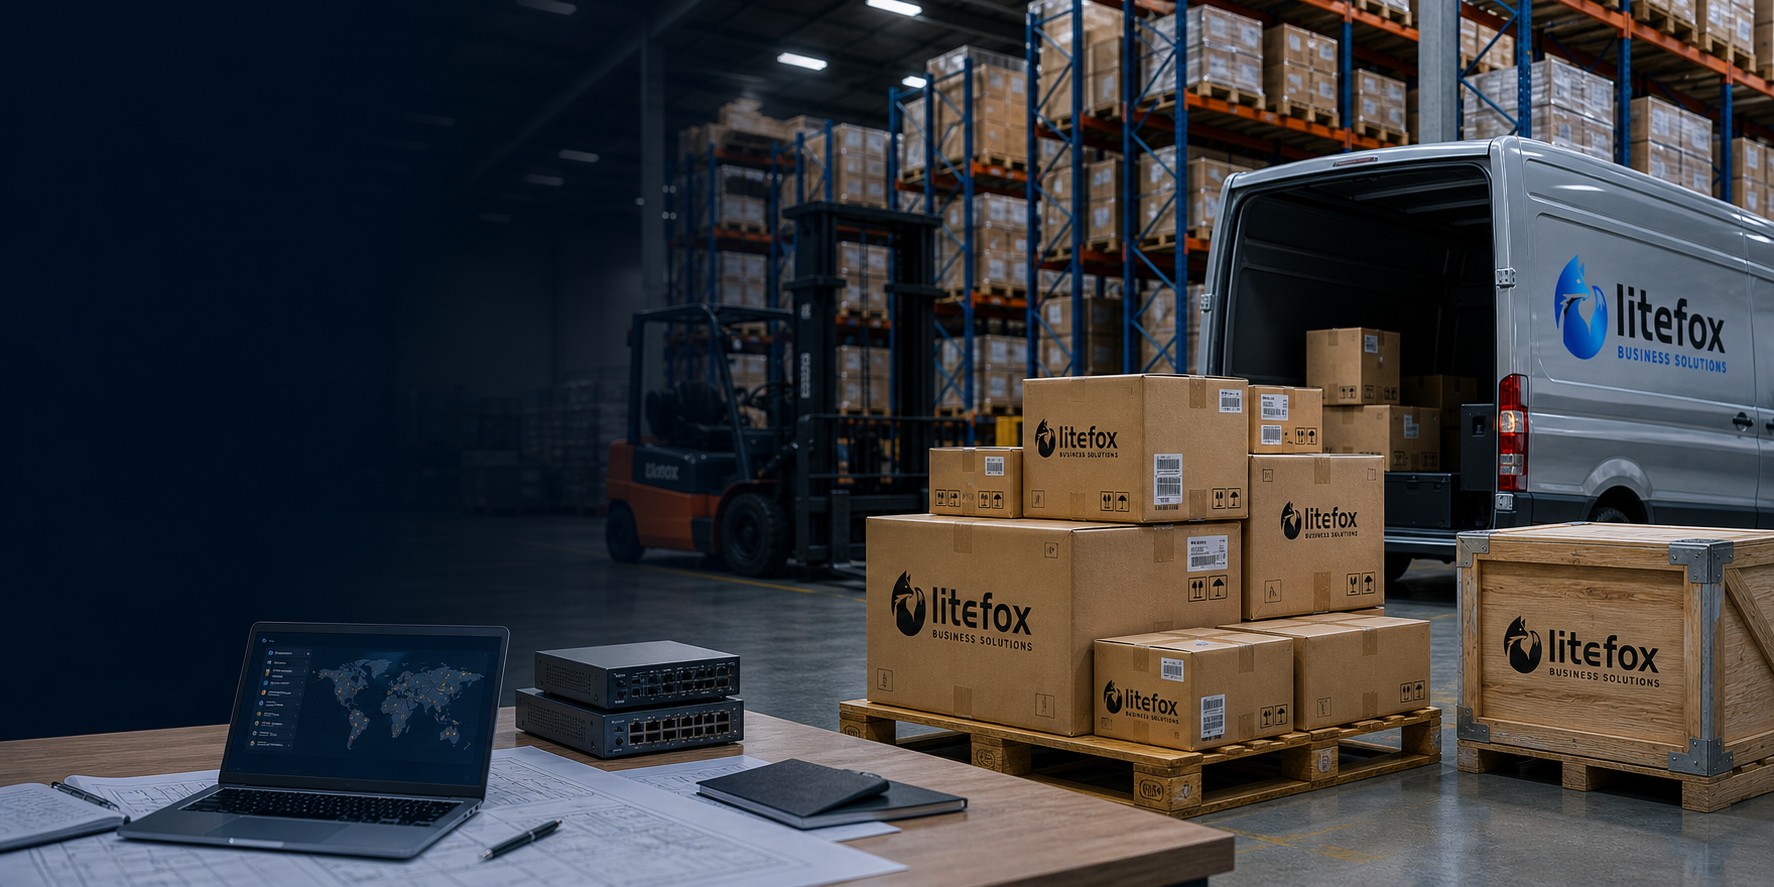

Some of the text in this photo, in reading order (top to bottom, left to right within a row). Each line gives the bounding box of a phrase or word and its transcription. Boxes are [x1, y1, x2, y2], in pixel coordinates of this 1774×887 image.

[1616, 283, 1726, 354] litefox
[1617, 345, 1727, 374] BUSINESS SOLUTIONS
[1059, 425, 1118, 449] litefox
[1305, 506, 1358, 530] litefox
[932, 586, 1032, 635] litefox
[932, 630, 1033, 651] BUSINESS SOLUTIONS
[1549, 629, 1660, 674] litefox
[1549, 667, 1660, 688] BUSINESS SOLUTIONS
[1125, 688, 1179, 717] litefox
